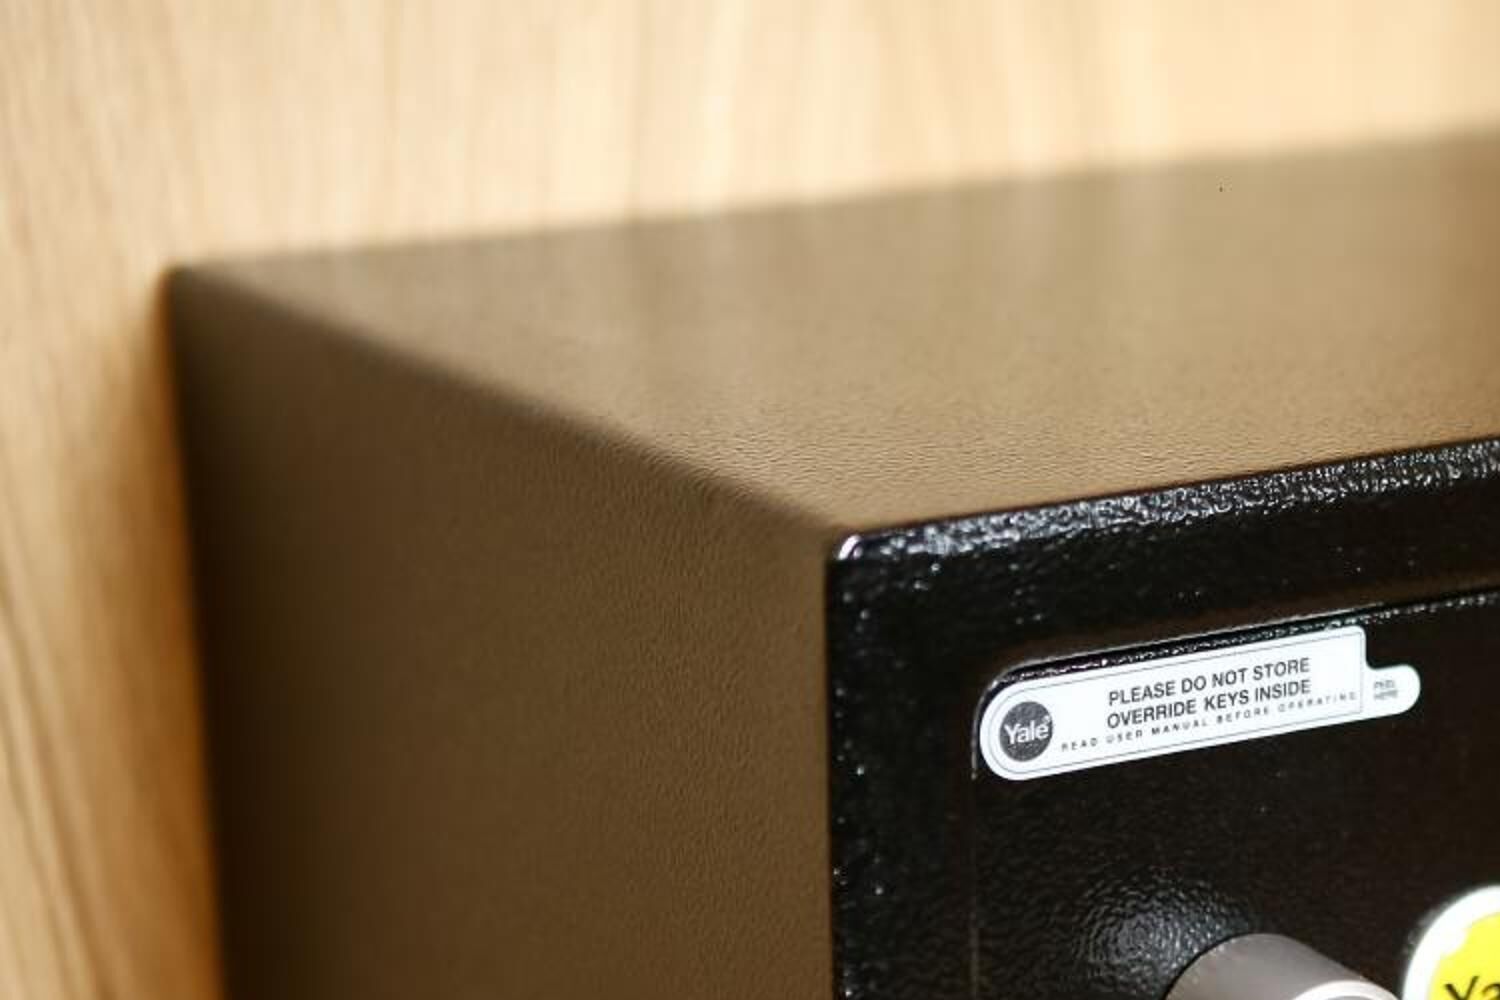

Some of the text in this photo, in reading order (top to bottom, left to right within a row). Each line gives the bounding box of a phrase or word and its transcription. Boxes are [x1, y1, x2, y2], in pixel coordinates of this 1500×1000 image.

[1109, 657, 1310, 706] PLEASE DO NOT STORE
[1107, 679, 1311, 728] OVERRIDE KEYS INSIDE
[1004, 720, 1049, 744] Yale
[1151, 718, 1208, 736] MANUAL
